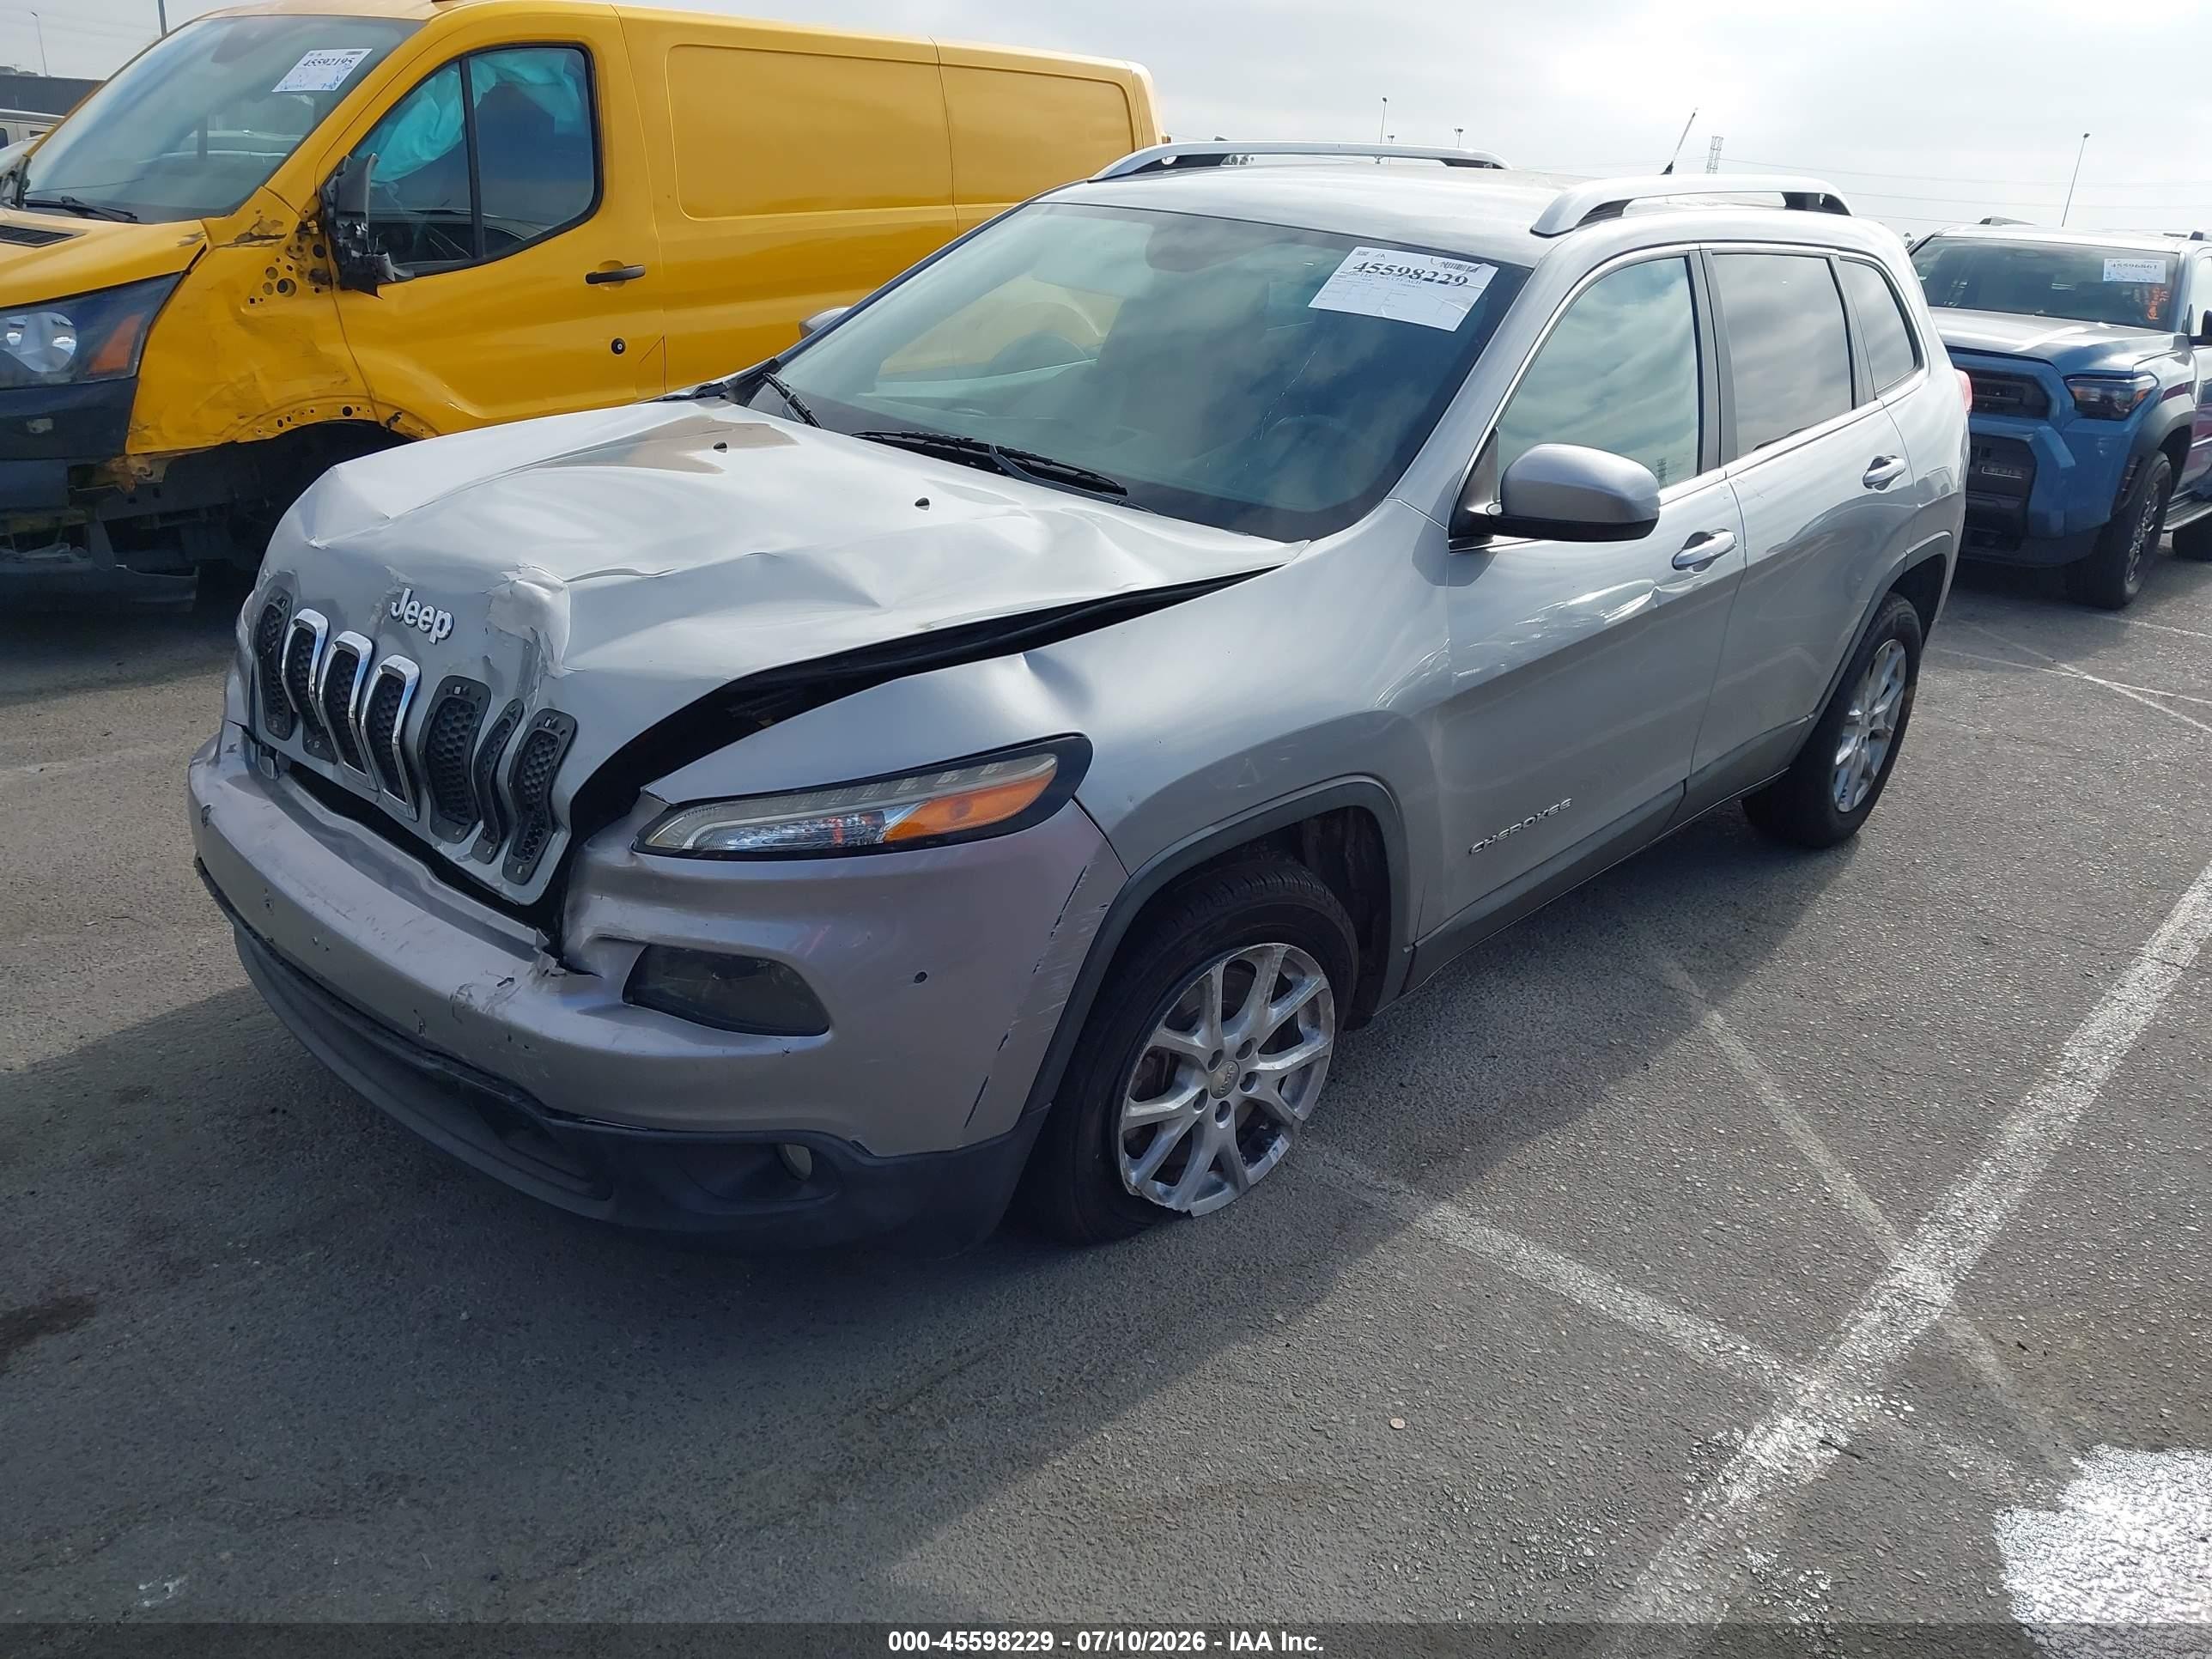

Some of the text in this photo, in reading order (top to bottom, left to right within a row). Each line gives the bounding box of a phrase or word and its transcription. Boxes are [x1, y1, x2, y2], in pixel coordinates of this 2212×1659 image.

[1352, 261, 1469, 287] 45598229
[391, 588, 454, 645] Jeep
[1469, 797, 1572, 854] CHEROKEE
